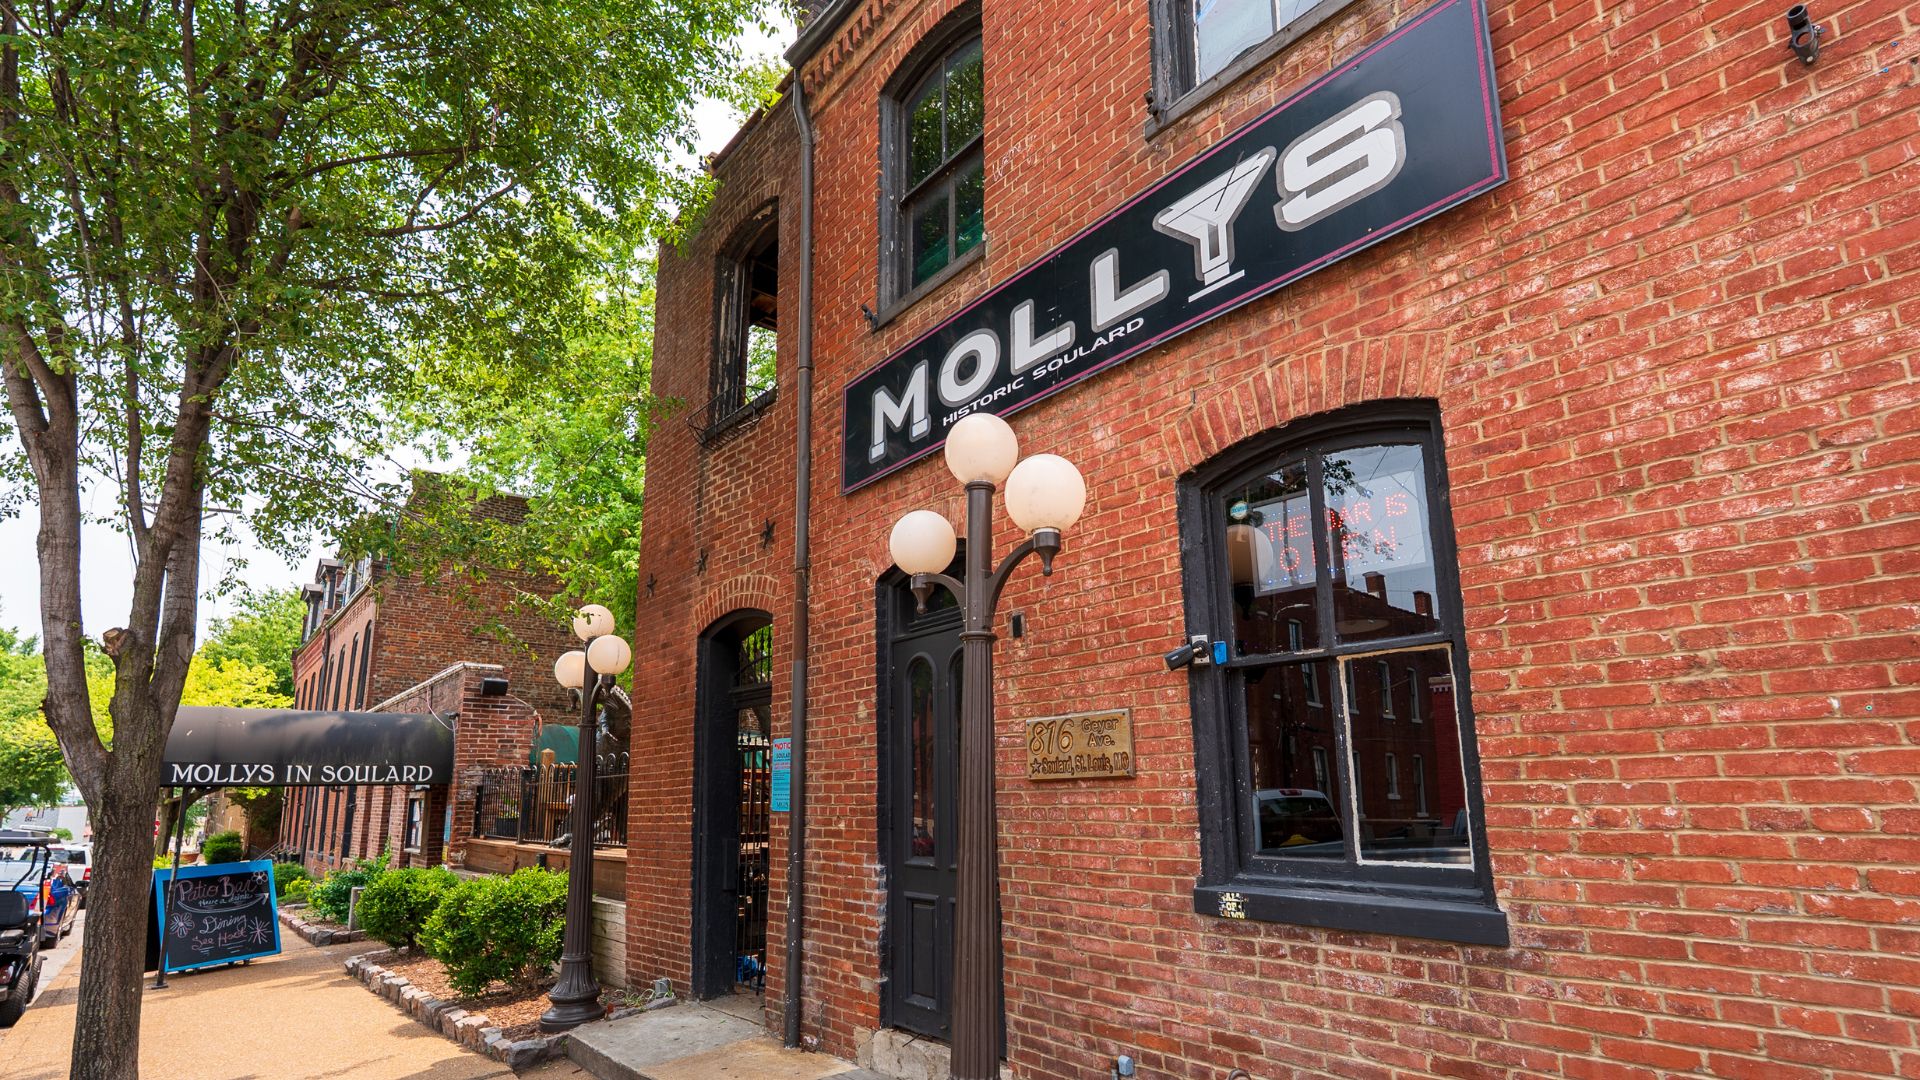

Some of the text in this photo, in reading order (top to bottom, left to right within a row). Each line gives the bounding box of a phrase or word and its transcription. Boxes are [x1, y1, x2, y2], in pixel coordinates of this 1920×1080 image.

[868, 90, 1406, 463] MOLLYS
[943, 317, 1145, 427] HISTORIC SOULARD
[1263, 514, 1309, 543] THE
[1029, 717, 1120, 755] 816 Geyer
[1087, 732, 1116, 748] Ave.
[171, 763, 433, 783] MOLLYS IN SOULARD
[1042, 755, 1075, 776] Soulard,
[176, 876, 257, 901] Patio Bar
[200, 914, 247, 934] Dining
[192, 936, 214, 950] See
